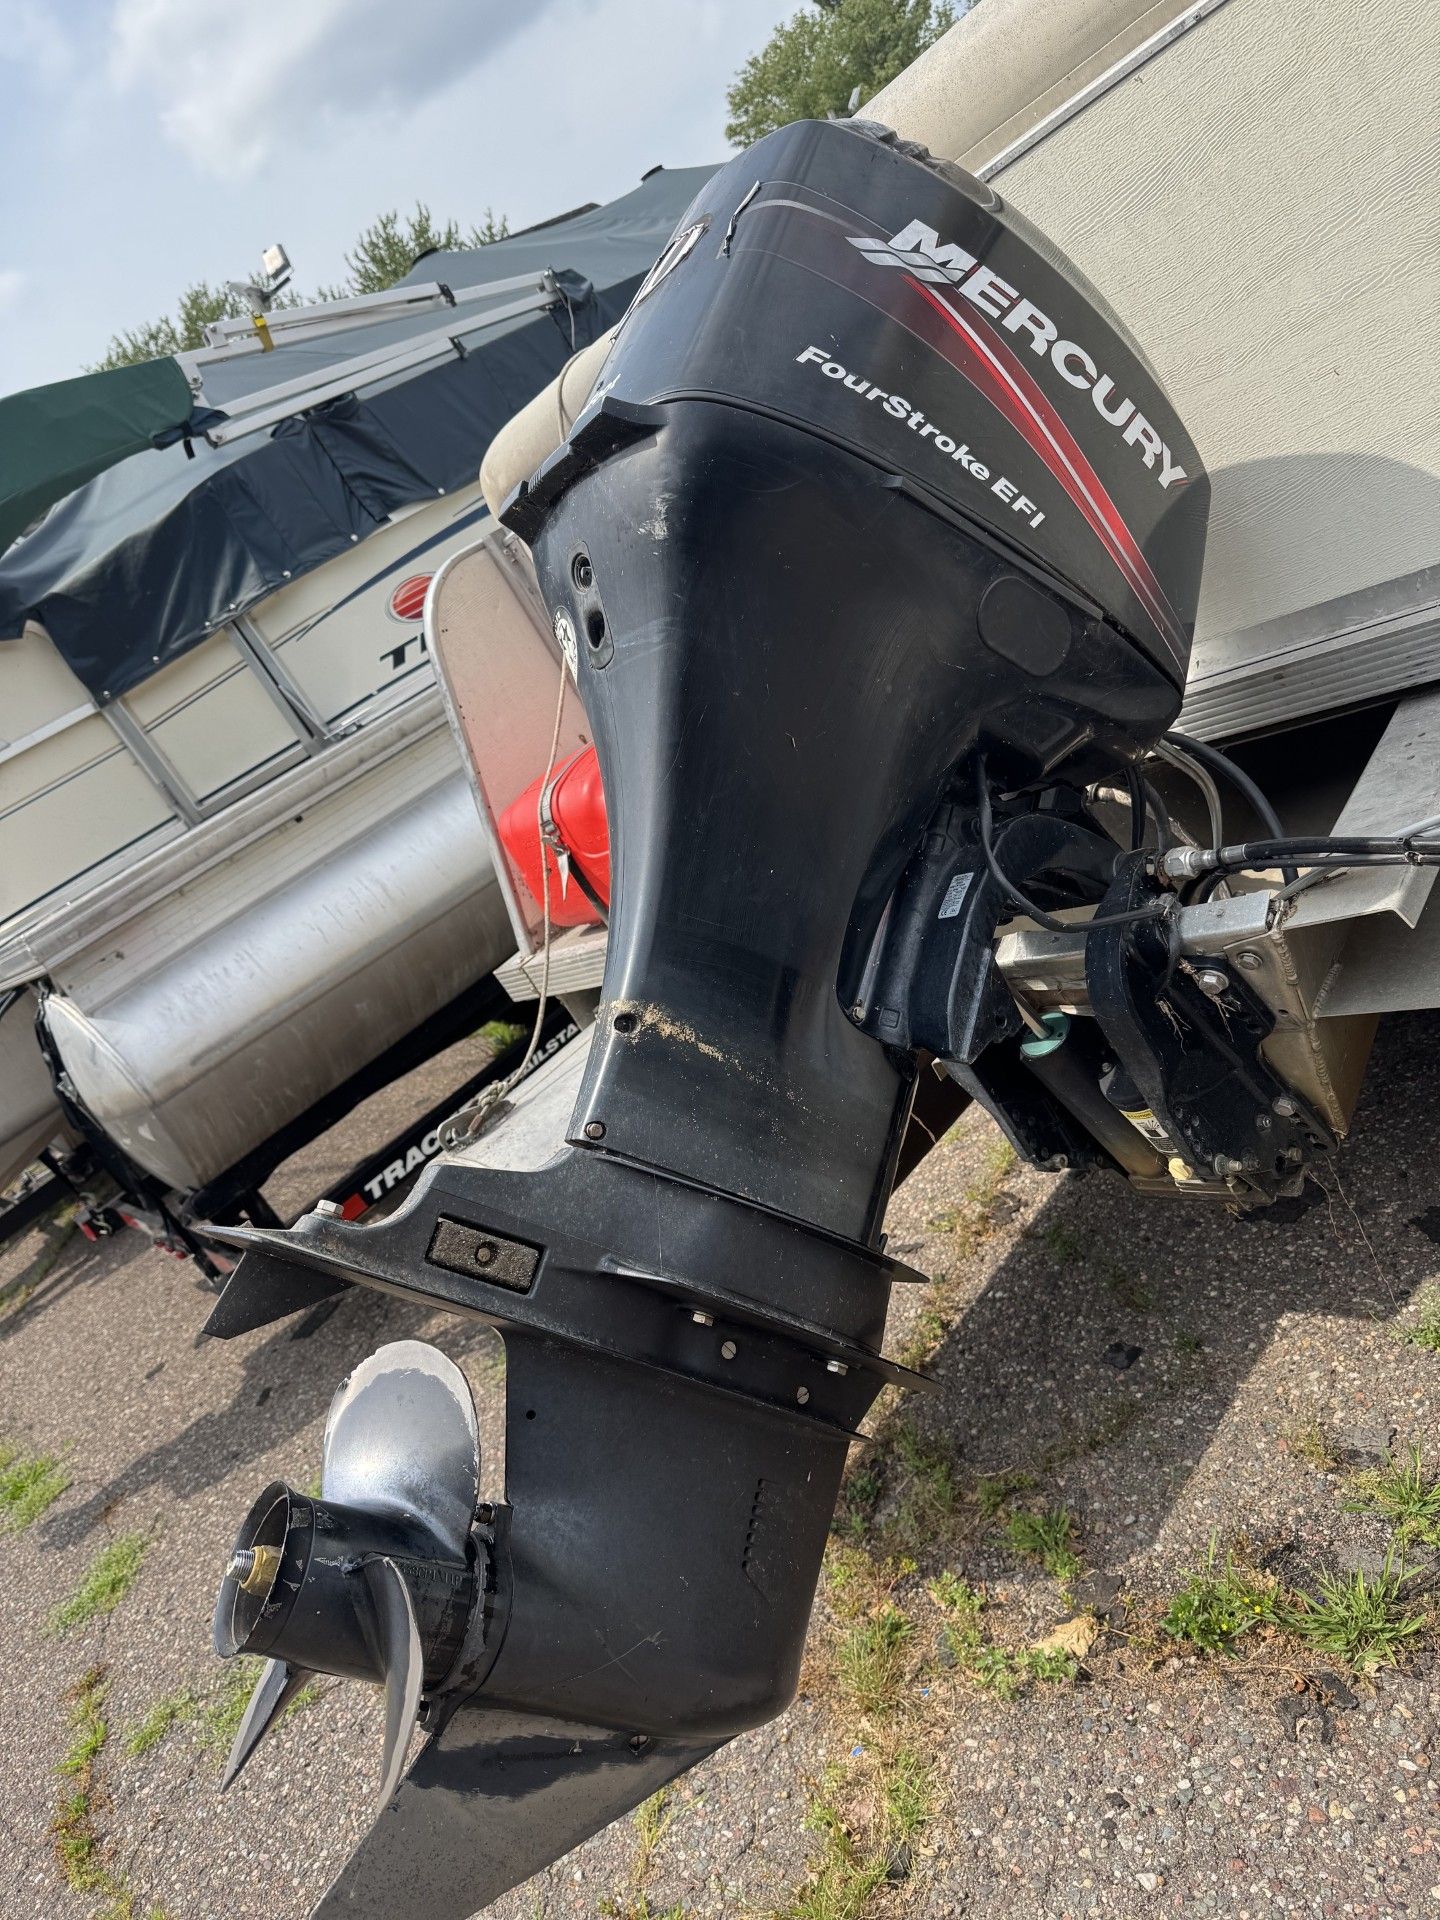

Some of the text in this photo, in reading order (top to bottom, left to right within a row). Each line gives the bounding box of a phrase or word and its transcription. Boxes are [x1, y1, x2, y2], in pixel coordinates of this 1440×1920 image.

[795, 345, 1046, 529] FourStroke EFI
[888, 218, 1188, 490] MERCURY
